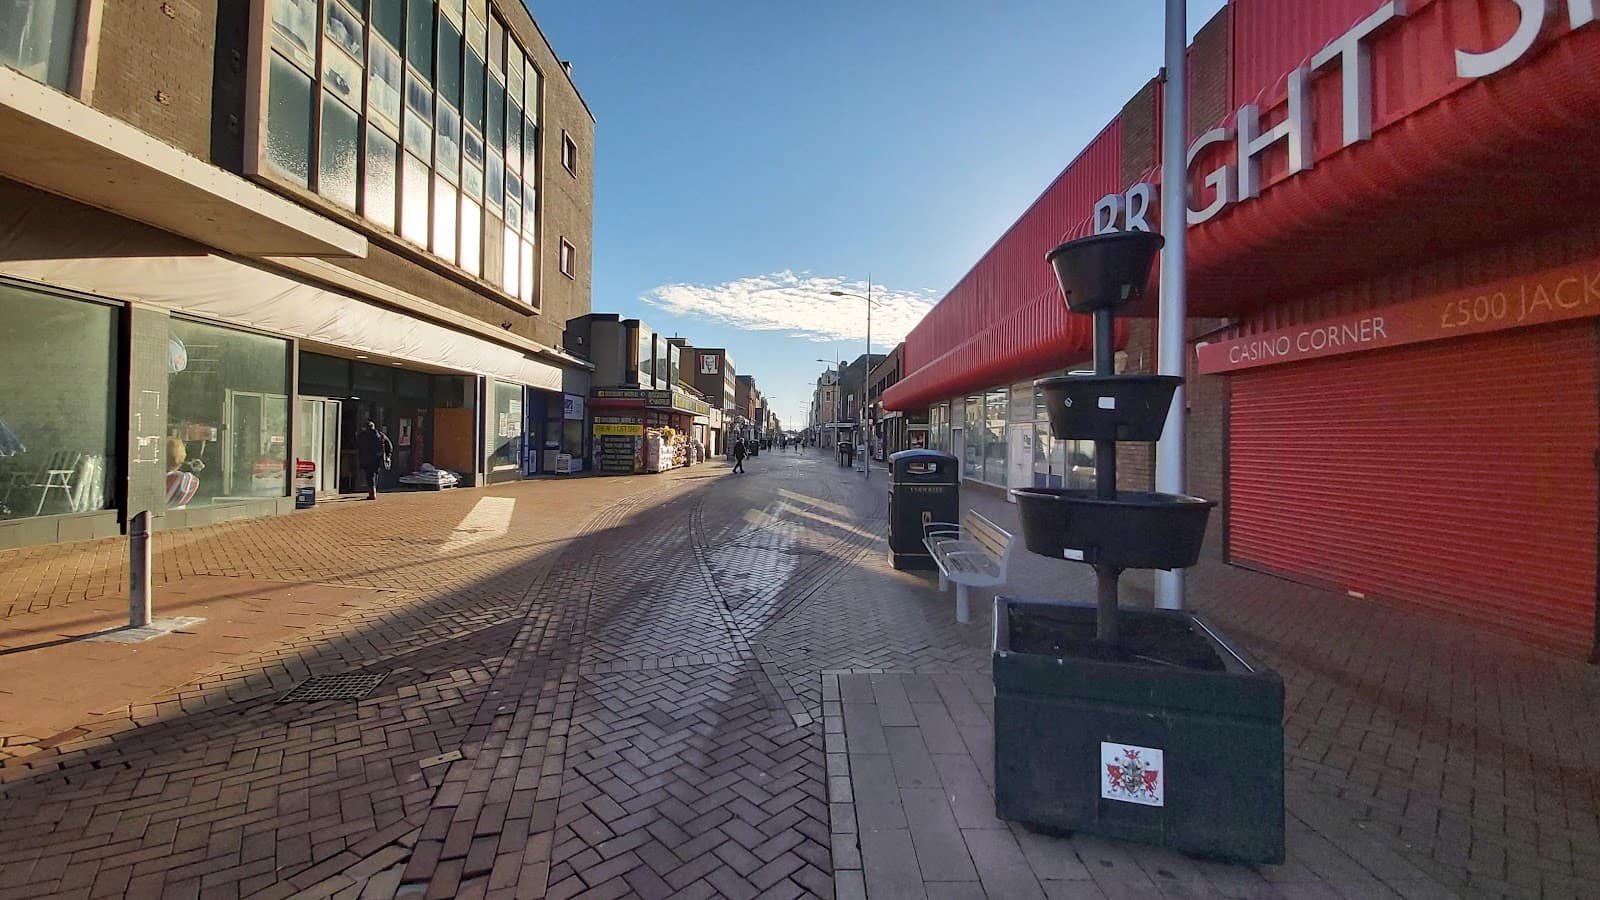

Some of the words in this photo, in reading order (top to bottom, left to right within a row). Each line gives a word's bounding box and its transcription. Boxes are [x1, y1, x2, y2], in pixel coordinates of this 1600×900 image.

[1094, 0, 1406, 235] BRGHT
[1229, 335, 1290, 364] CASINO
[1296, 316, 1388, 352] CORNER
[1441, 291, 1507, 329] £500
